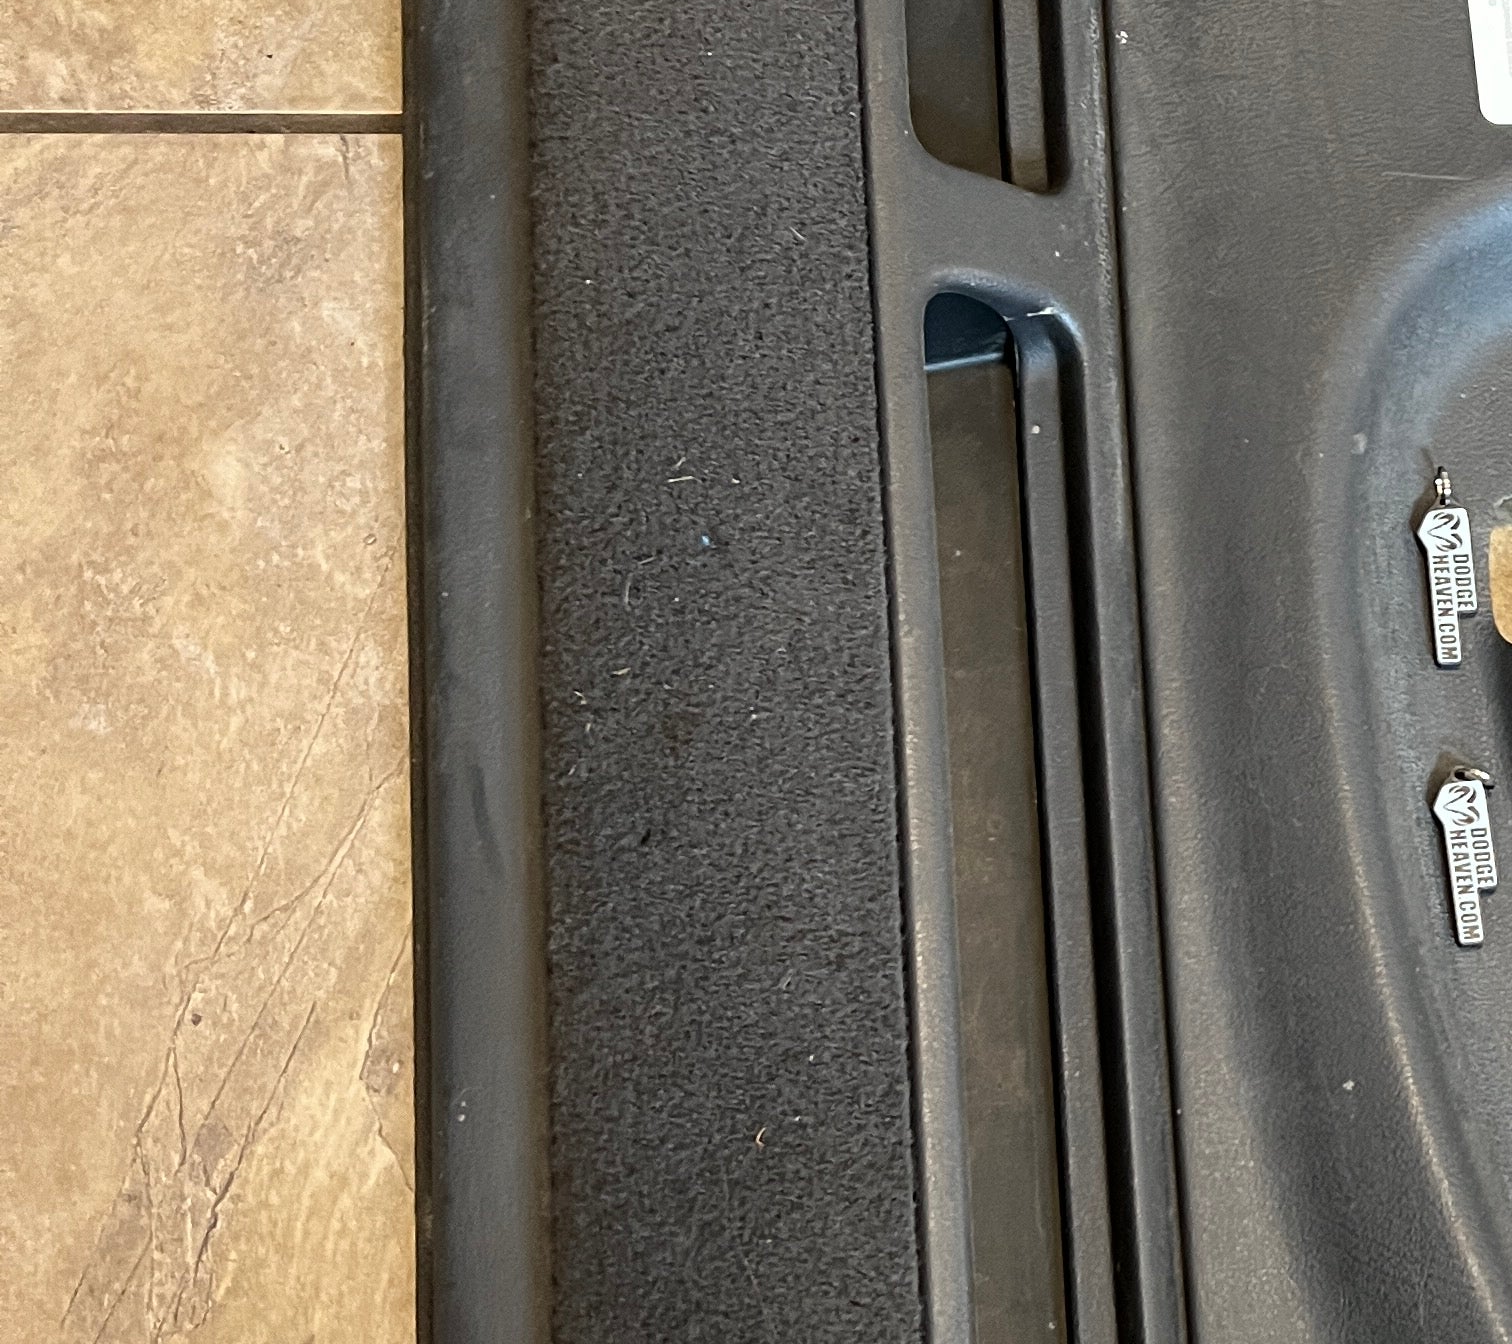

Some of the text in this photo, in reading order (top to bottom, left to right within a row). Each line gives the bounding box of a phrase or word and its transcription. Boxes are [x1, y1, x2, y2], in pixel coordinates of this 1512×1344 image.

[1432, 554, 1459, 661] HEAVEN.COM
[1453, 553, 1475, 609] DODGE
[1450, 829, 1481, 940] HEAVEN.COM
[1470, 827, 1495, 884] DODGE
